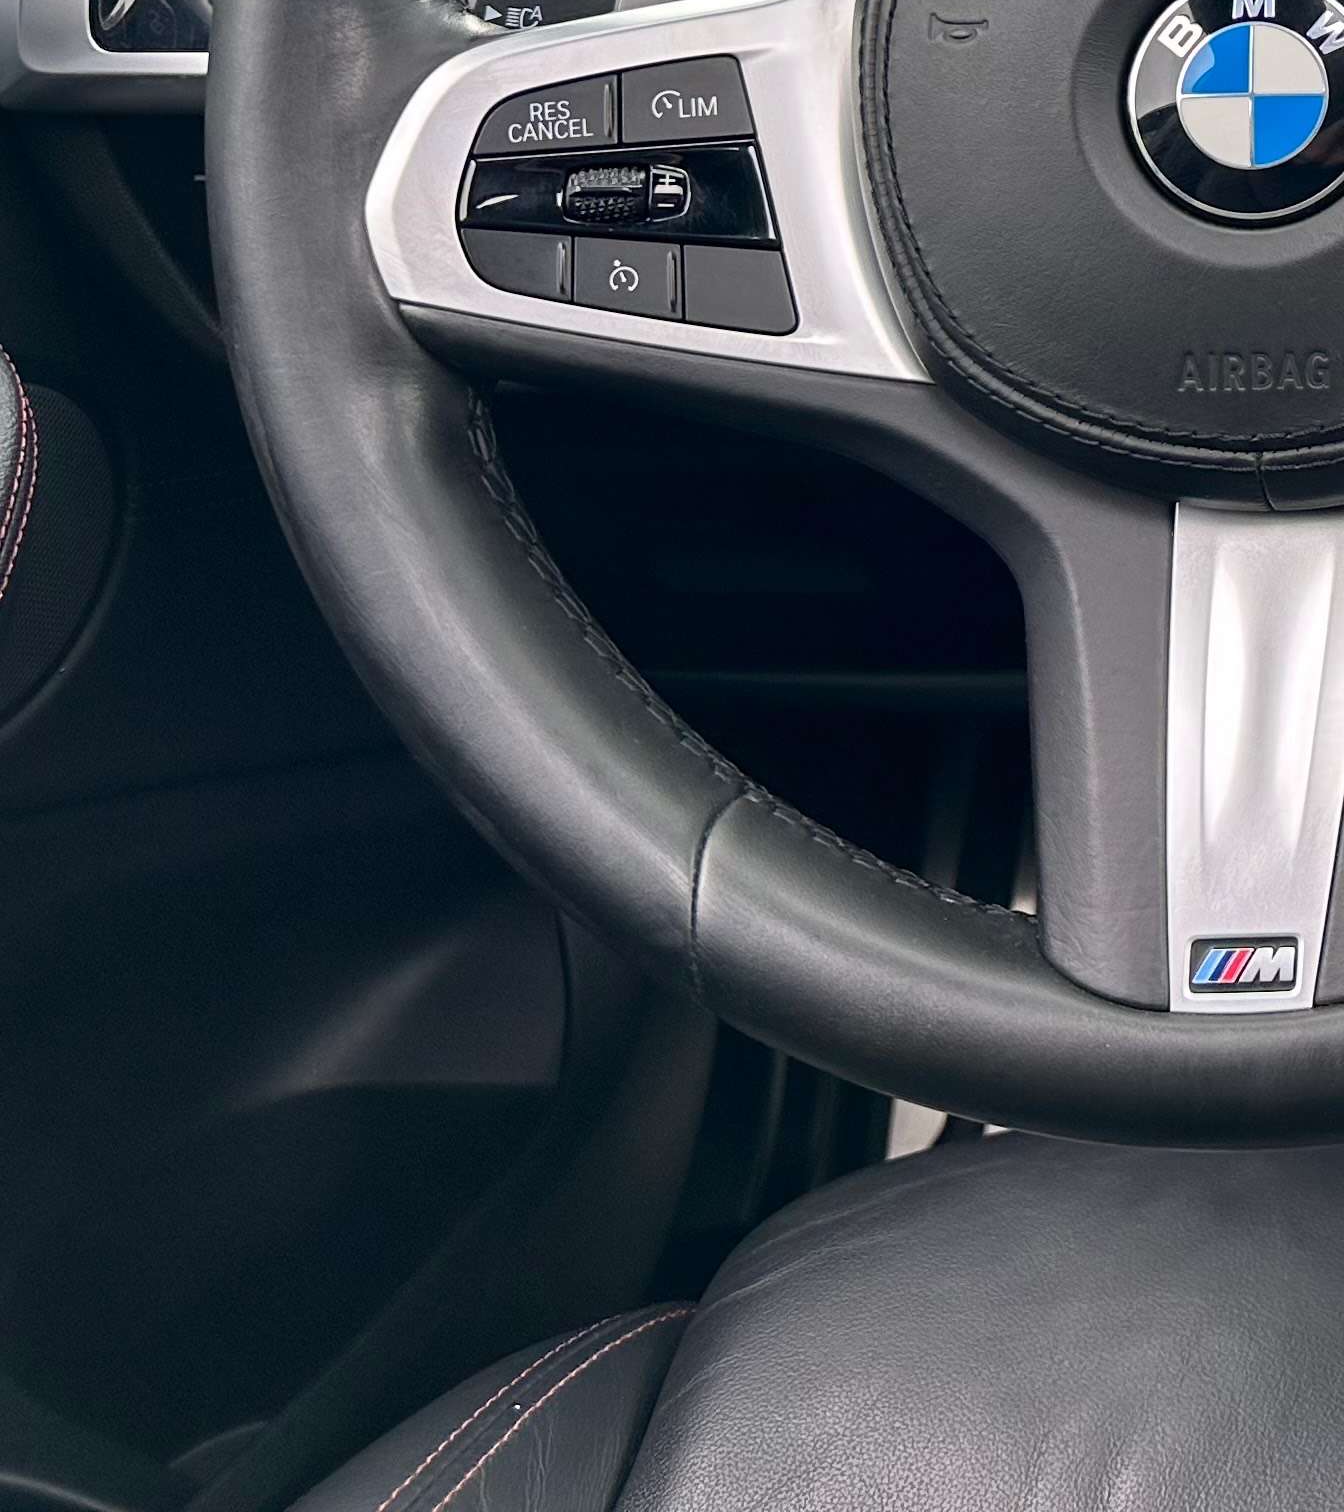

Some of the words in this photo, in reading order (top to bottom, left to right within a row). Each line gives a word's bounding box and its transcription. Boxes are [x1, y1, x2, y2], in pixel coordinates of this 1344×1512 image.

[529, 100, 570, 122] RES
[678, 95, 718, 119] LIM
[507, 119, 594, 144] CANCEL
[1177, 351, 1330, 392] AIRBAG
